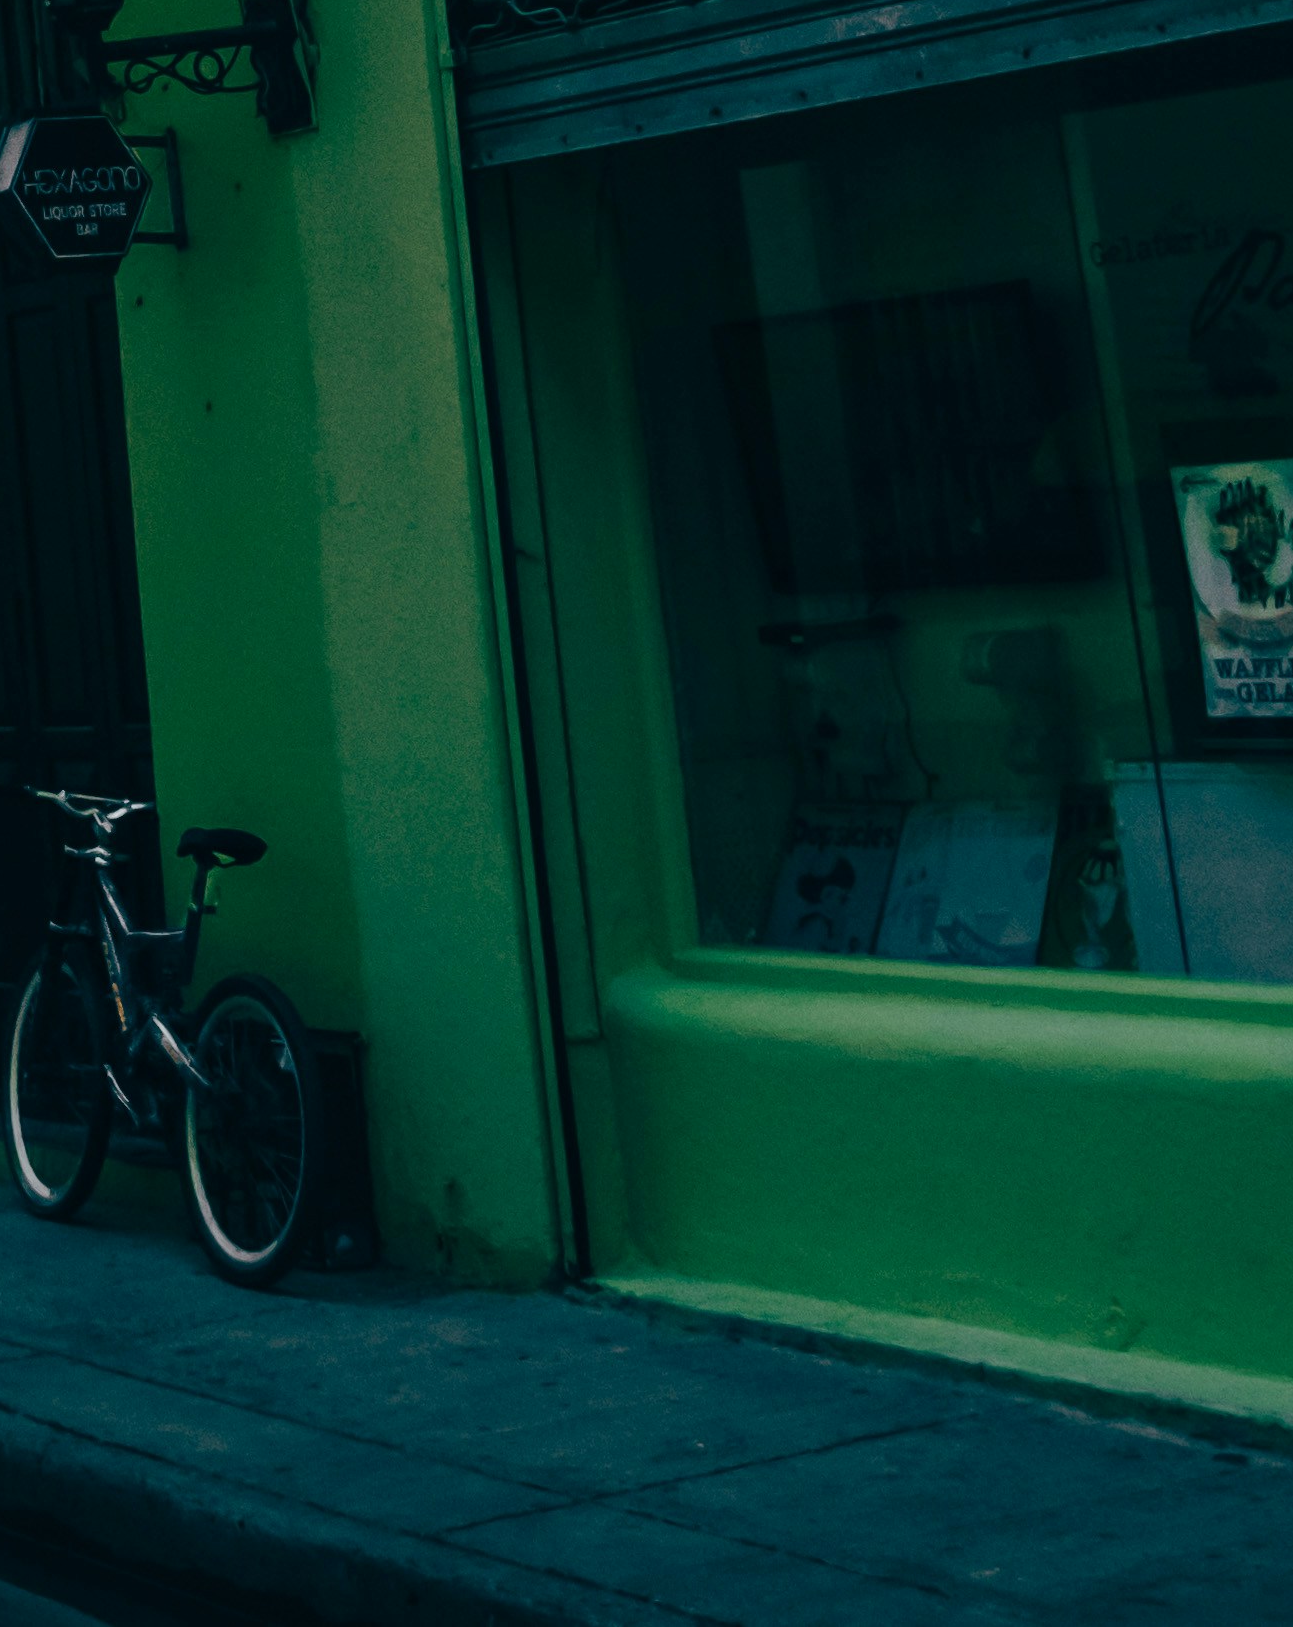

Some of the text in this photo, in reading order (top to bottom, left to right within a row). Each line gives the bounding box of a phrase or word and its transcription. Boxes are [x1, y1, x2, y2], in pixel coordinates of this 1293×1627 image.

[43, 202, 127, 220] LIQUOR STORE
[76, 223, 98, 236] BAR
